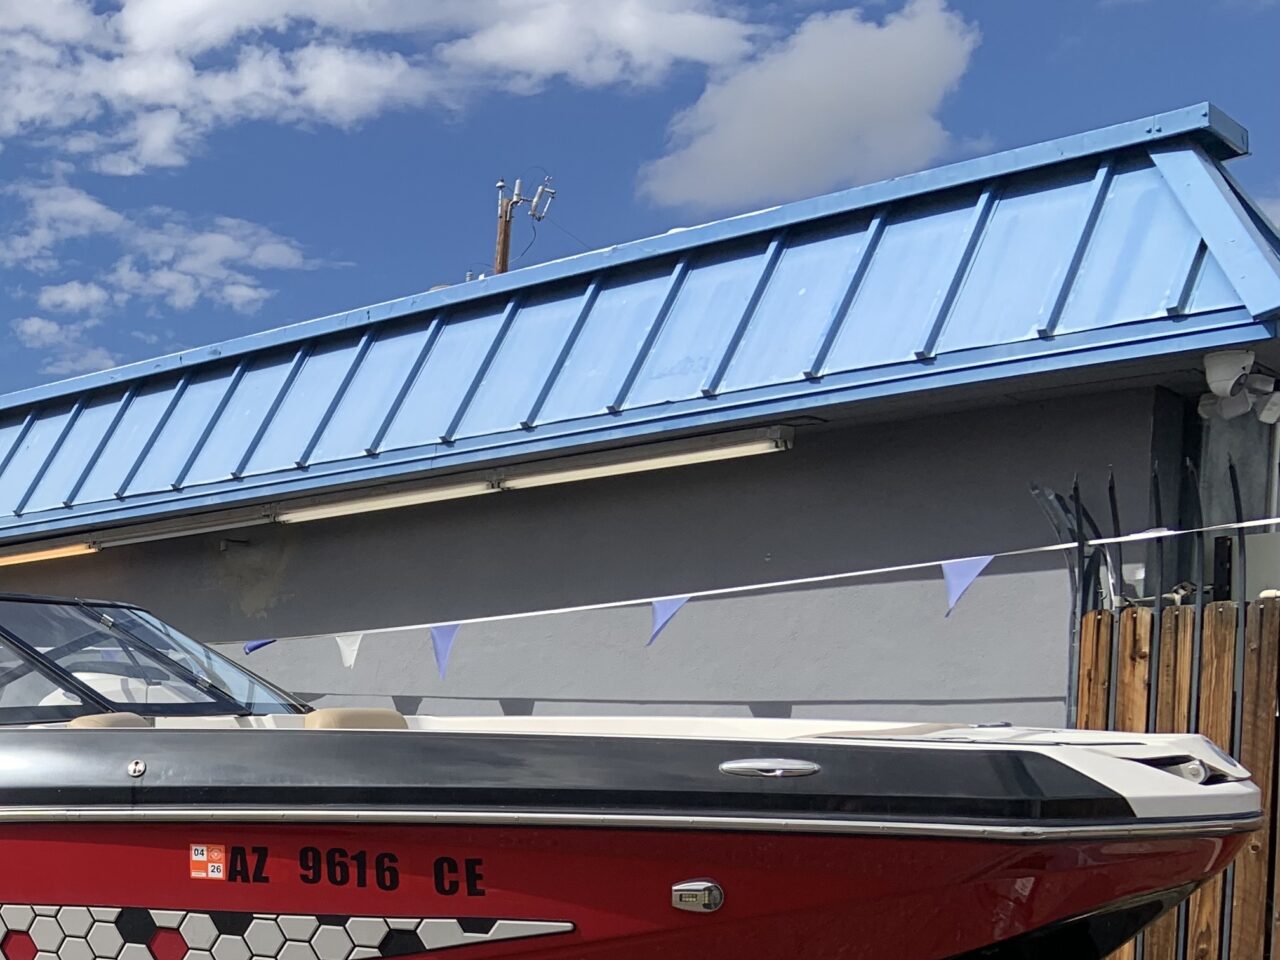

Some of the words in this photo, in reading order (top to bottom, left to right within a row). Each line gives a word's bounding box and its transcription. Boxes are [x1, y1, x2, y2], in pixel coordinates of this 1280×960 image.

[193, 848, 205, 857] 04
[210, 865, 222, 873] 26
[227, 846, 269, 883] AZ
[299, 846, 399, 891] 9616
[433, 856, 486, 897] CE
